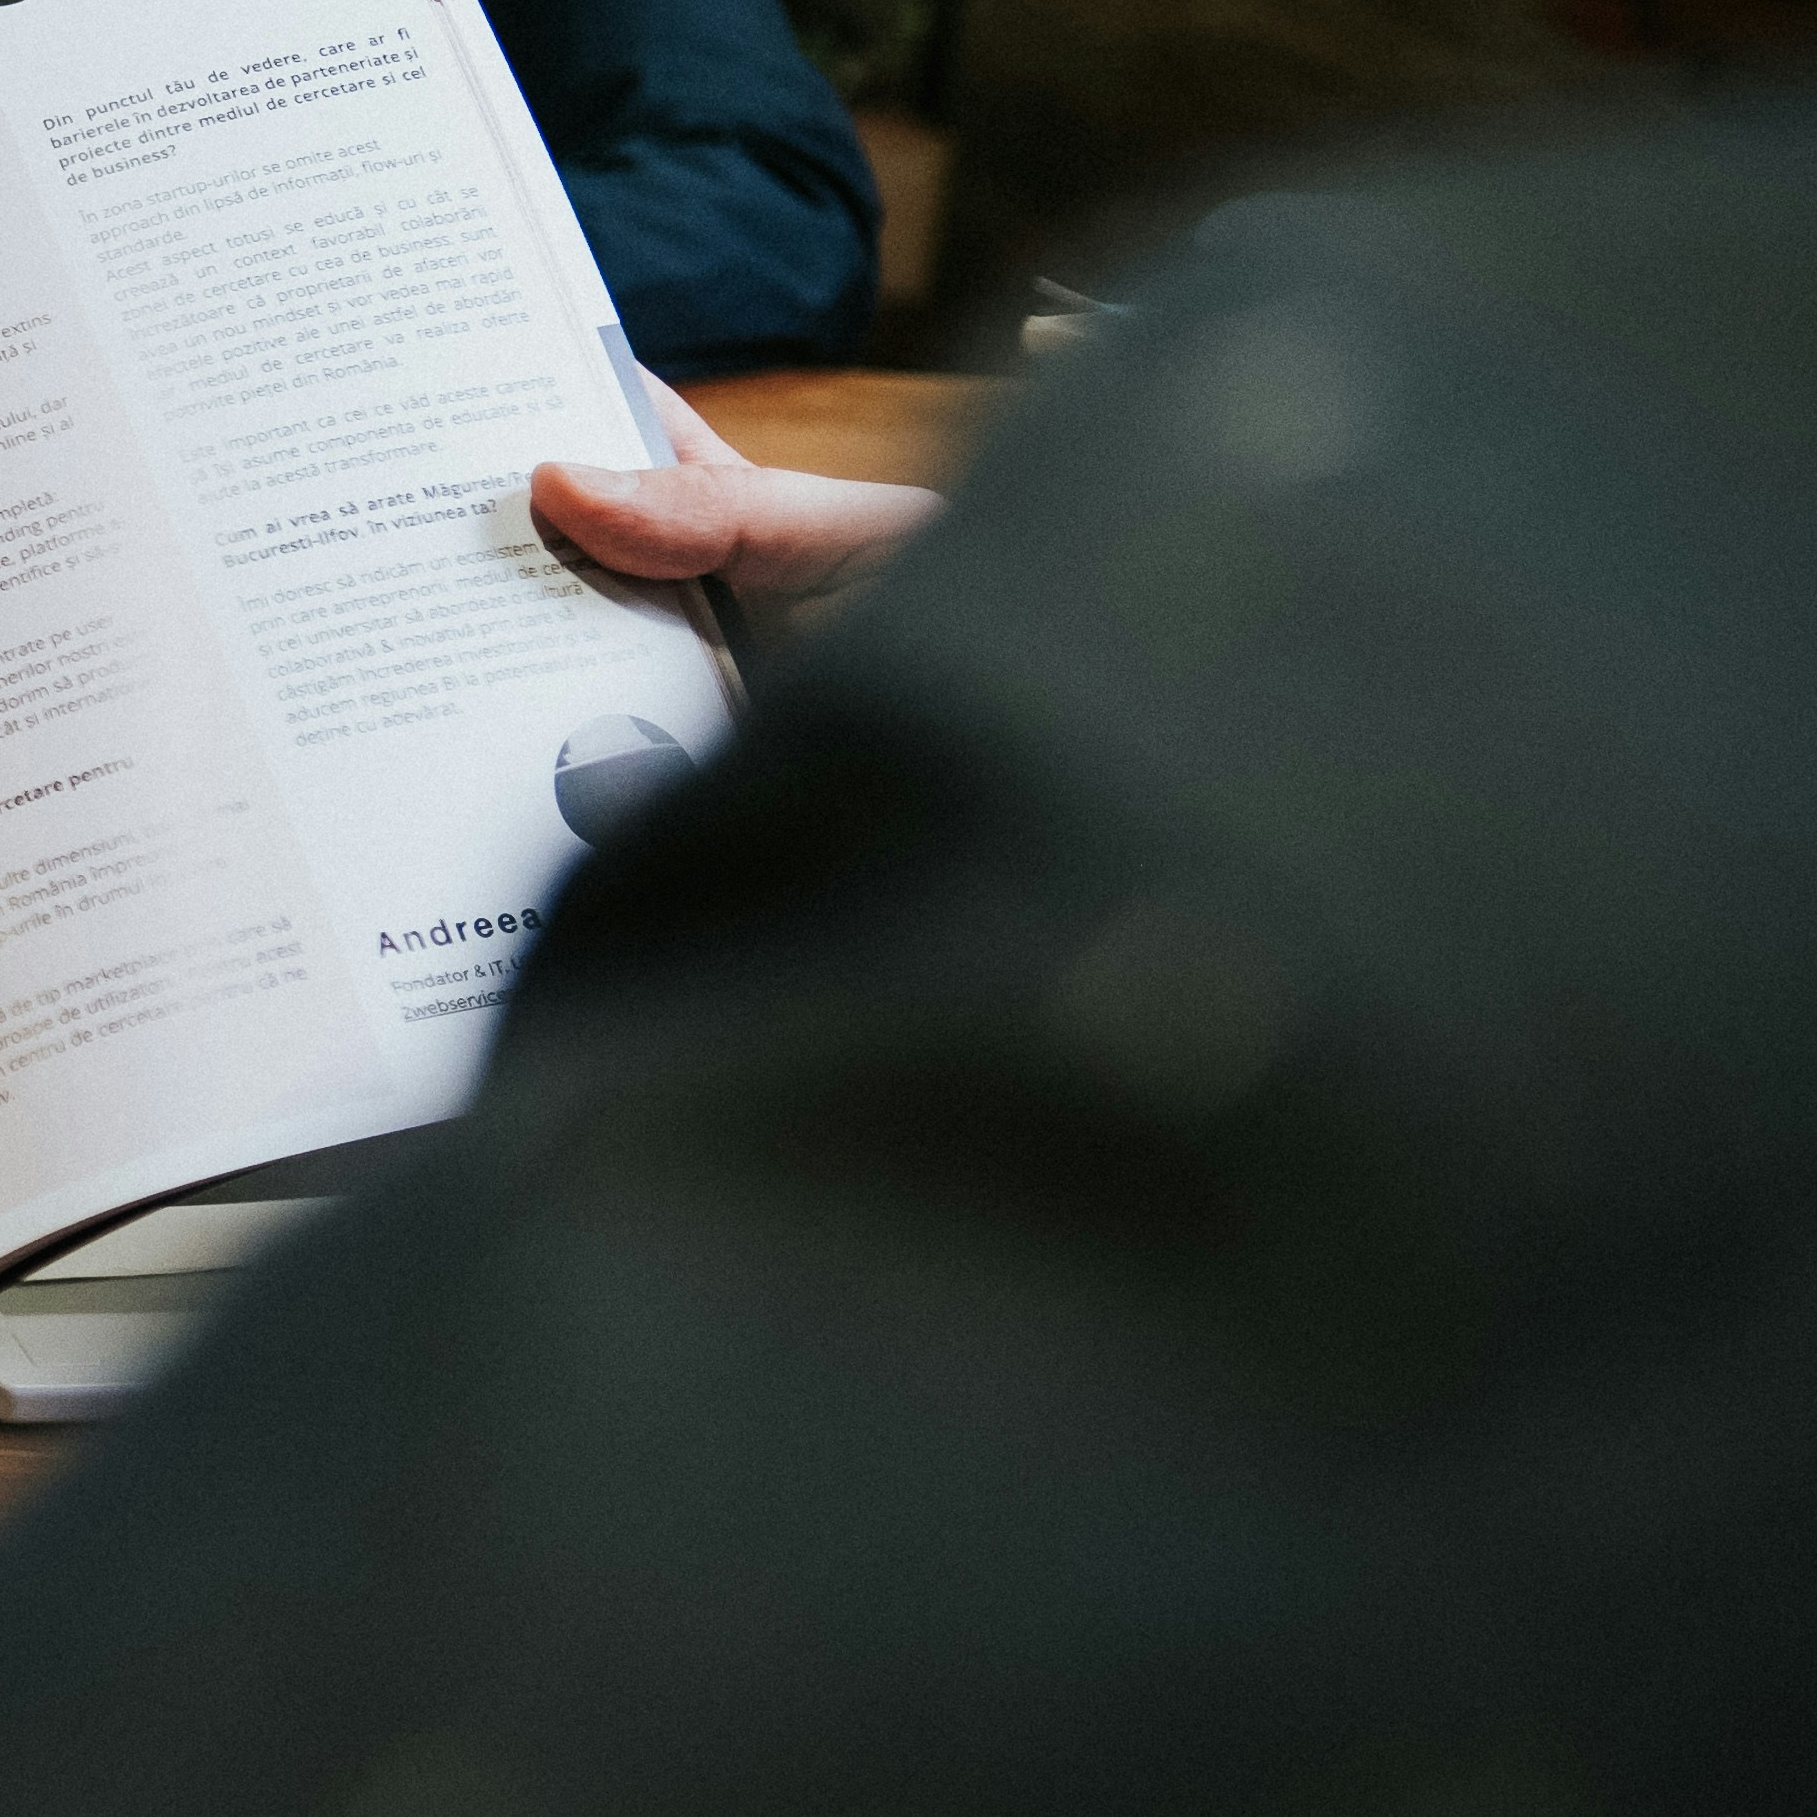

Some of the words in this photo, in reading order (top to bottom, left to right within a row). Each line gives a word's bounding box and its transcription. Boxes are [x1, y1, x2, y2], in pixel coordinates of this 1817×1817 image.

[42, 115, 73, 130] Din
[85, 87, 153, 121] punctul
[165, 79, 195, 94] tău
[207, 70, 229, 83] de
[318, 41, 355, 56] care
[368, 34, 384, 46] ar
[397, 27, 410, 40] fi
[49, 118, 130, 148] barierele
[131, 111, 152, 124] în
[156, 84, 260, 117] dezvoltarea
[264, 77, 285, 89] de
[290, 53, 400, 86] parteneriate
[58, 139, 131, 170] proiecte
[137, 122, 192, 144] dintre
[198, 101, 259, 127] mediul
[265, 97, 287, 110] de
[294, 78, 375, 104] cercetare
[402, 65, 426, 81] cel
[66, 173, 87, 186] de
[90, 144, 176, 178] business?
[367, 492, 415, 510] arate
[470, 498, 497, 515] ta?
[68, 756, 134, 789] pentru
[379, 907, 542, 958] Andreea
[390, 969, 469, 995] Fondator
[473, 964, 487, 979] &
